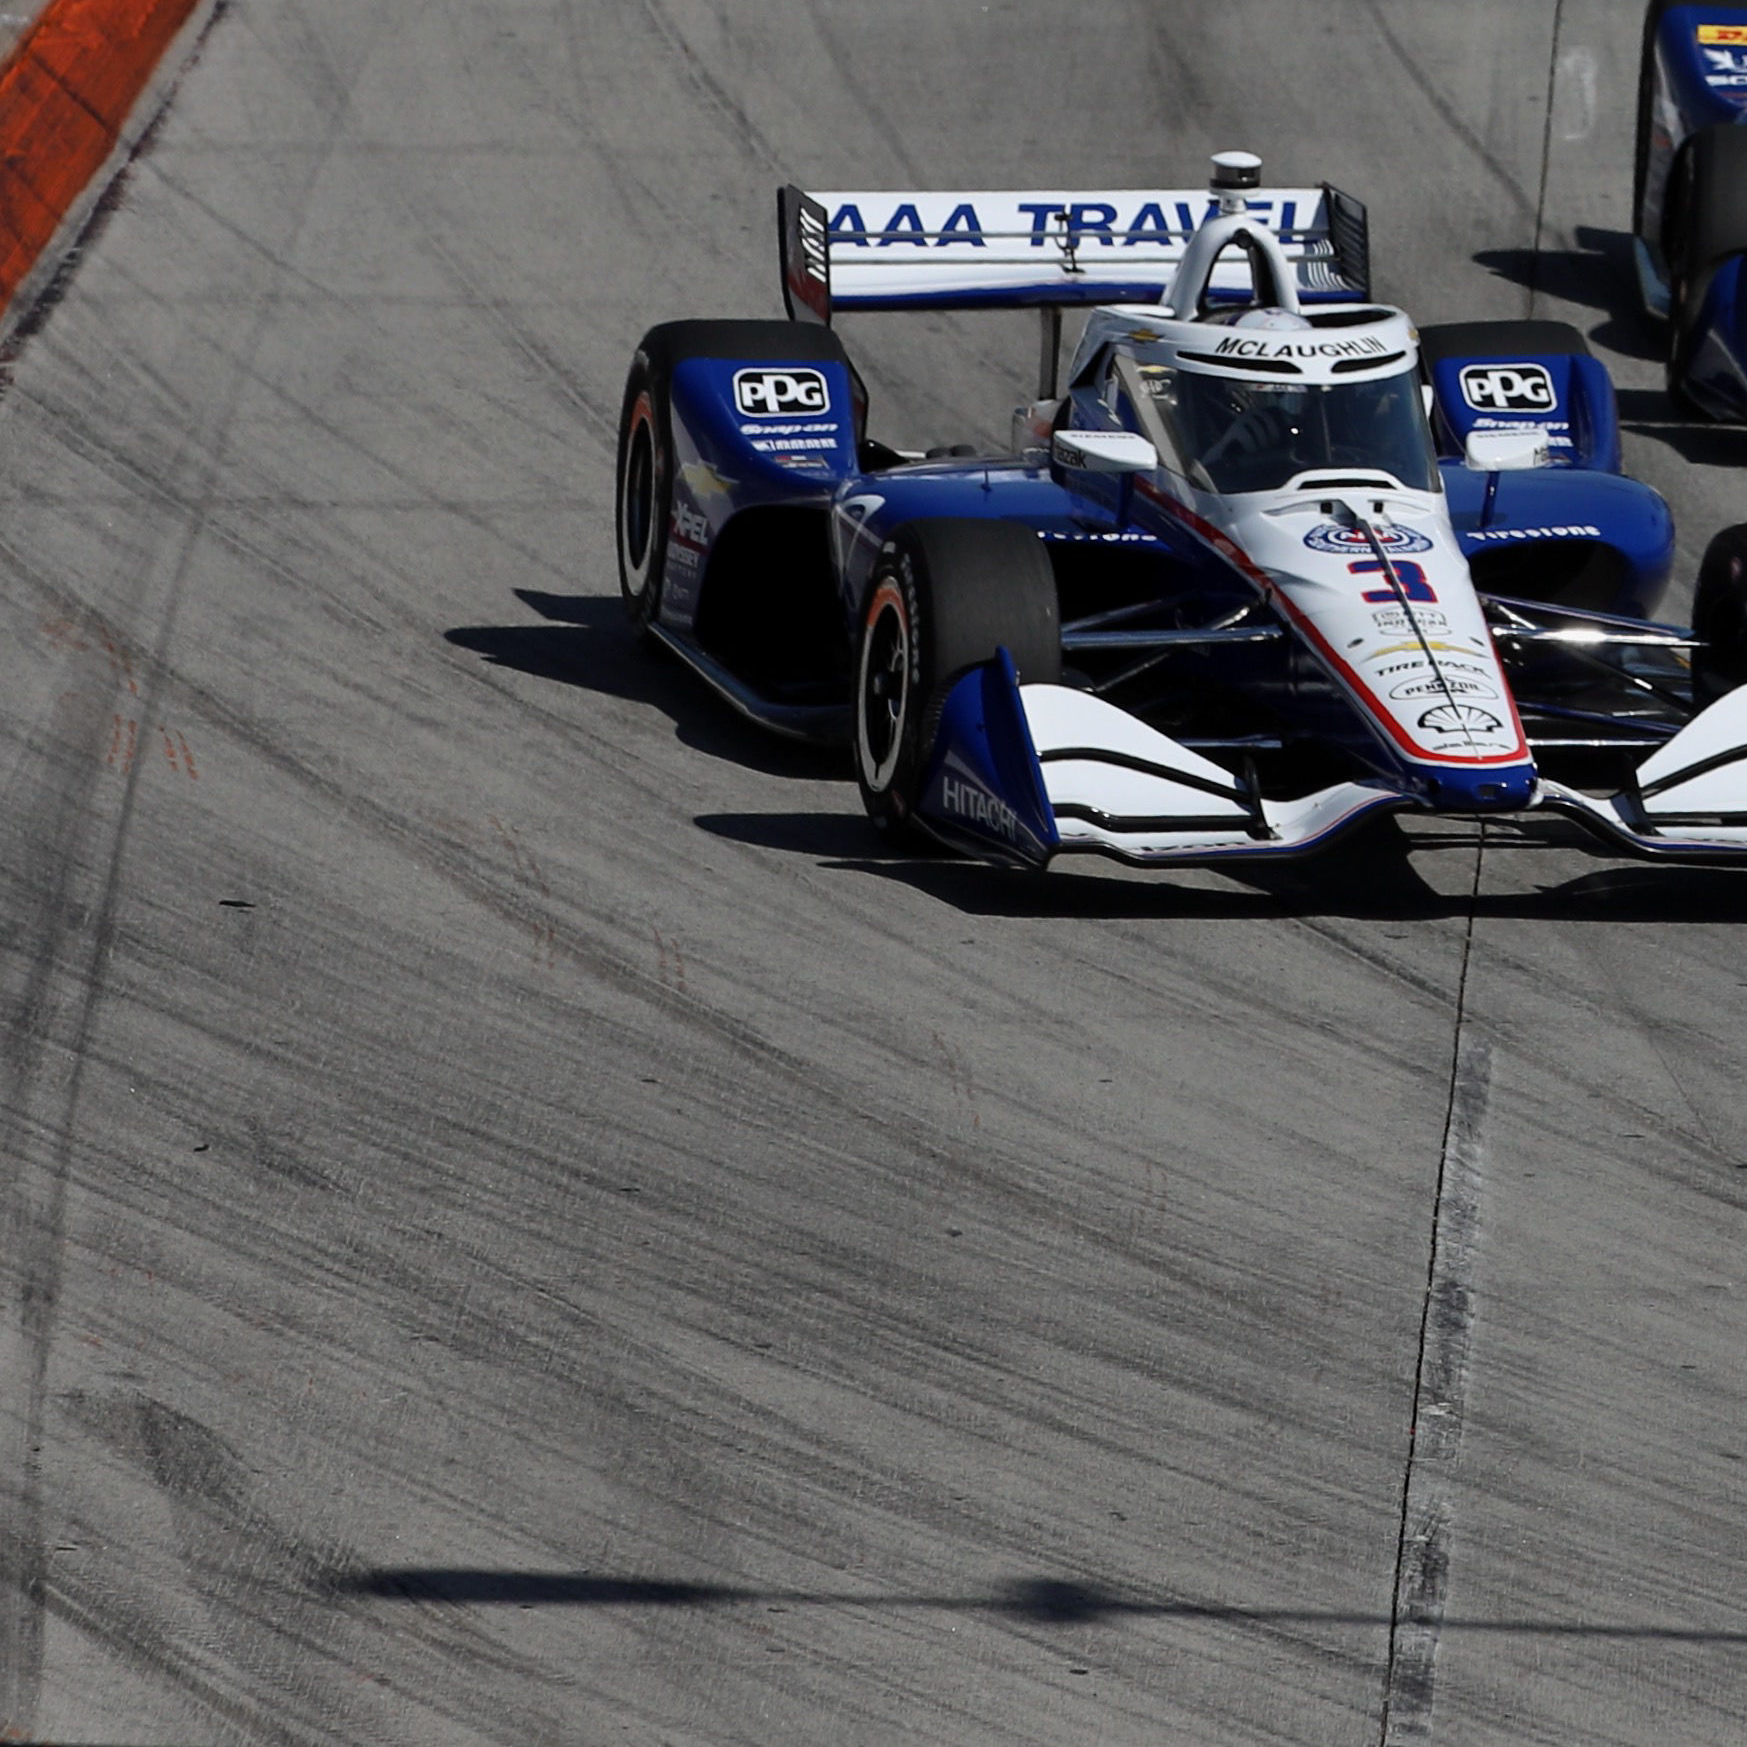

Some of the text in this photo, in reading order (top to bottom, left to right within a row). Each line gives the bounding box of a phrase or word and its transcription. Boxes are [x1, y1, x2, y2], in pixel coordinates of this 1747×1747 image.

[827, 203, 988, 248] AAA
[1215, 336, 1389, 358] MCLAUGHLIN
[740, 374, 825, 413] PPG
[1466, 370, 1551, 408] PPG
[675, 500, 710, 545] XPEL
[1037, 531, 1158, 543] restone
[1466, 525, 1601, 541] Firestone
[1347, 560, 1440, 604] 3
[943, 776, 1019, 842] HITACHI
